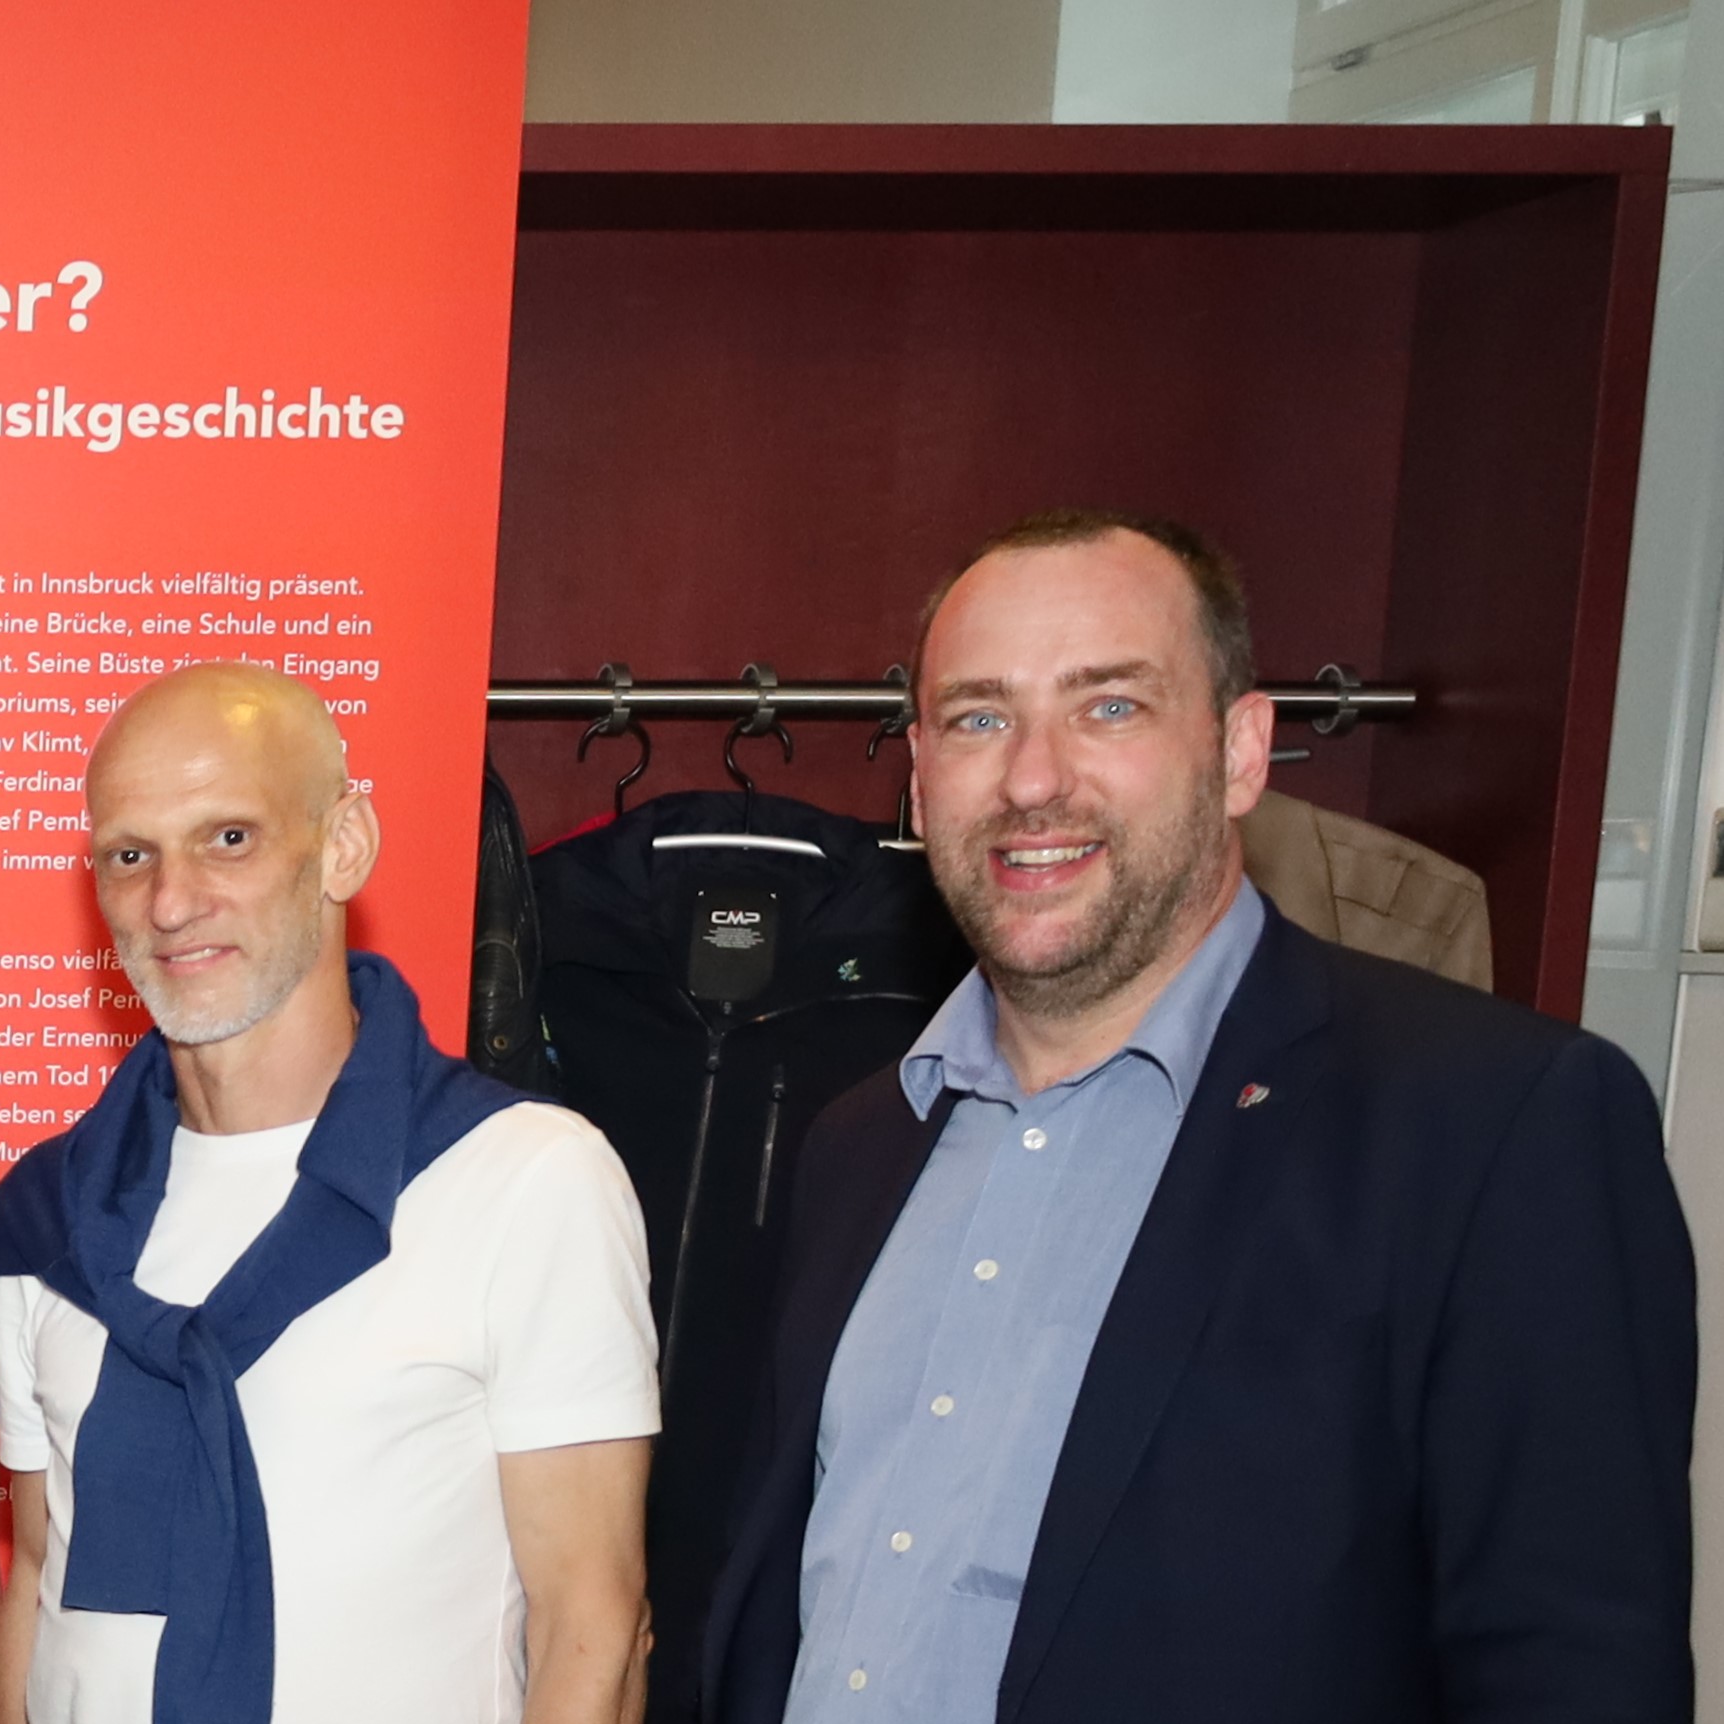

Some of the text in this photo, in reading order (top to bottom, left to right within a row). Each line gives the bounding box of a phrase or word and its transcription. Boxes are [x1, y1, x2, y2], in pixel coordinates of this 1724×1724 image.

[13, 572, 33, 593] in
[41, 571, 154, 595] Innsbruck
[161, 571, 262, 600] vielfältig
[268, 573, 364, 600] präsent.
[47, 611, 133, 637] Brücke,
[141, 612, 192, 635] eine
[199, 611, 277, 635] Schule
[284, 612, 330, 636] und
[336, 613, 372, 636] ein
[27, 651, 92, 674] Seine
[99, 651, 165, 674] Büste
[283, 653, 380, 681] Eingang
[324, 699, 368, 715] von
[22, 730, 89, 756] Klimt,
[28, 809, 91, 832] Pemb
[2, 849, 77, 871] immer
[710, 910, 761, 925] CMP
[62, 948, 123, 971] vielfä
[28, 986, 92, 1009] Josef
[98, 988, 142, 1009] Pem
[42, 1025, 143, 1048] Ernennu
[45, 1064, 89, 1086] Tod
